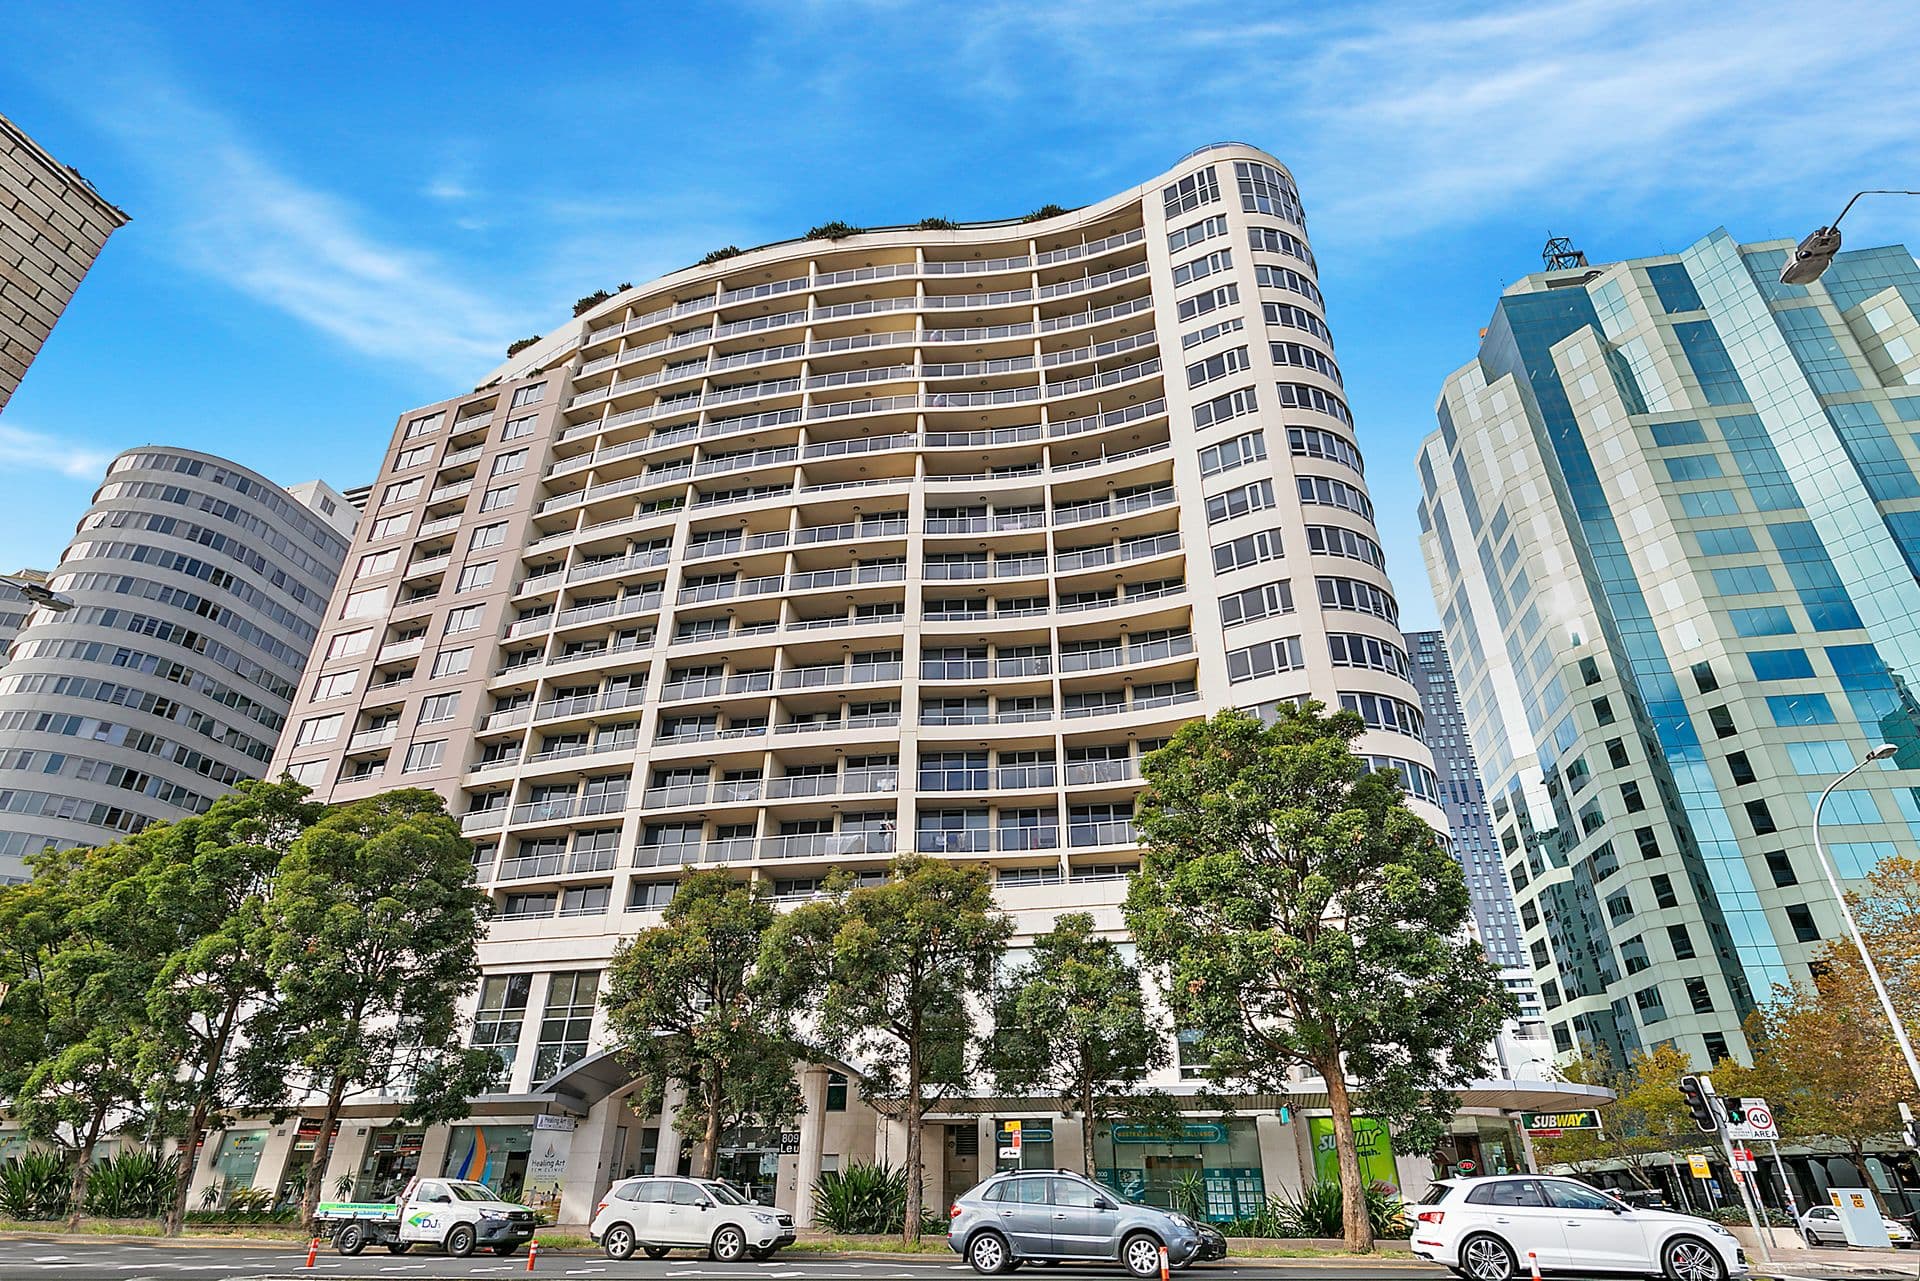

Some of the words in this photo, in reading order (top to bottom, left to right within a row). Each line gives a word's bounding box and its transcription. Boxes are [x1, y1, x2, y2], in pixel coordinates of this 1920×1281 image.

[1532, 1113, 1587, 1128] SUBWAY
[1752, 1113, 1768, 1124] 40
[782, 1133, 799, 1143] 809
[531, 1160, 555, 1168] Healing
